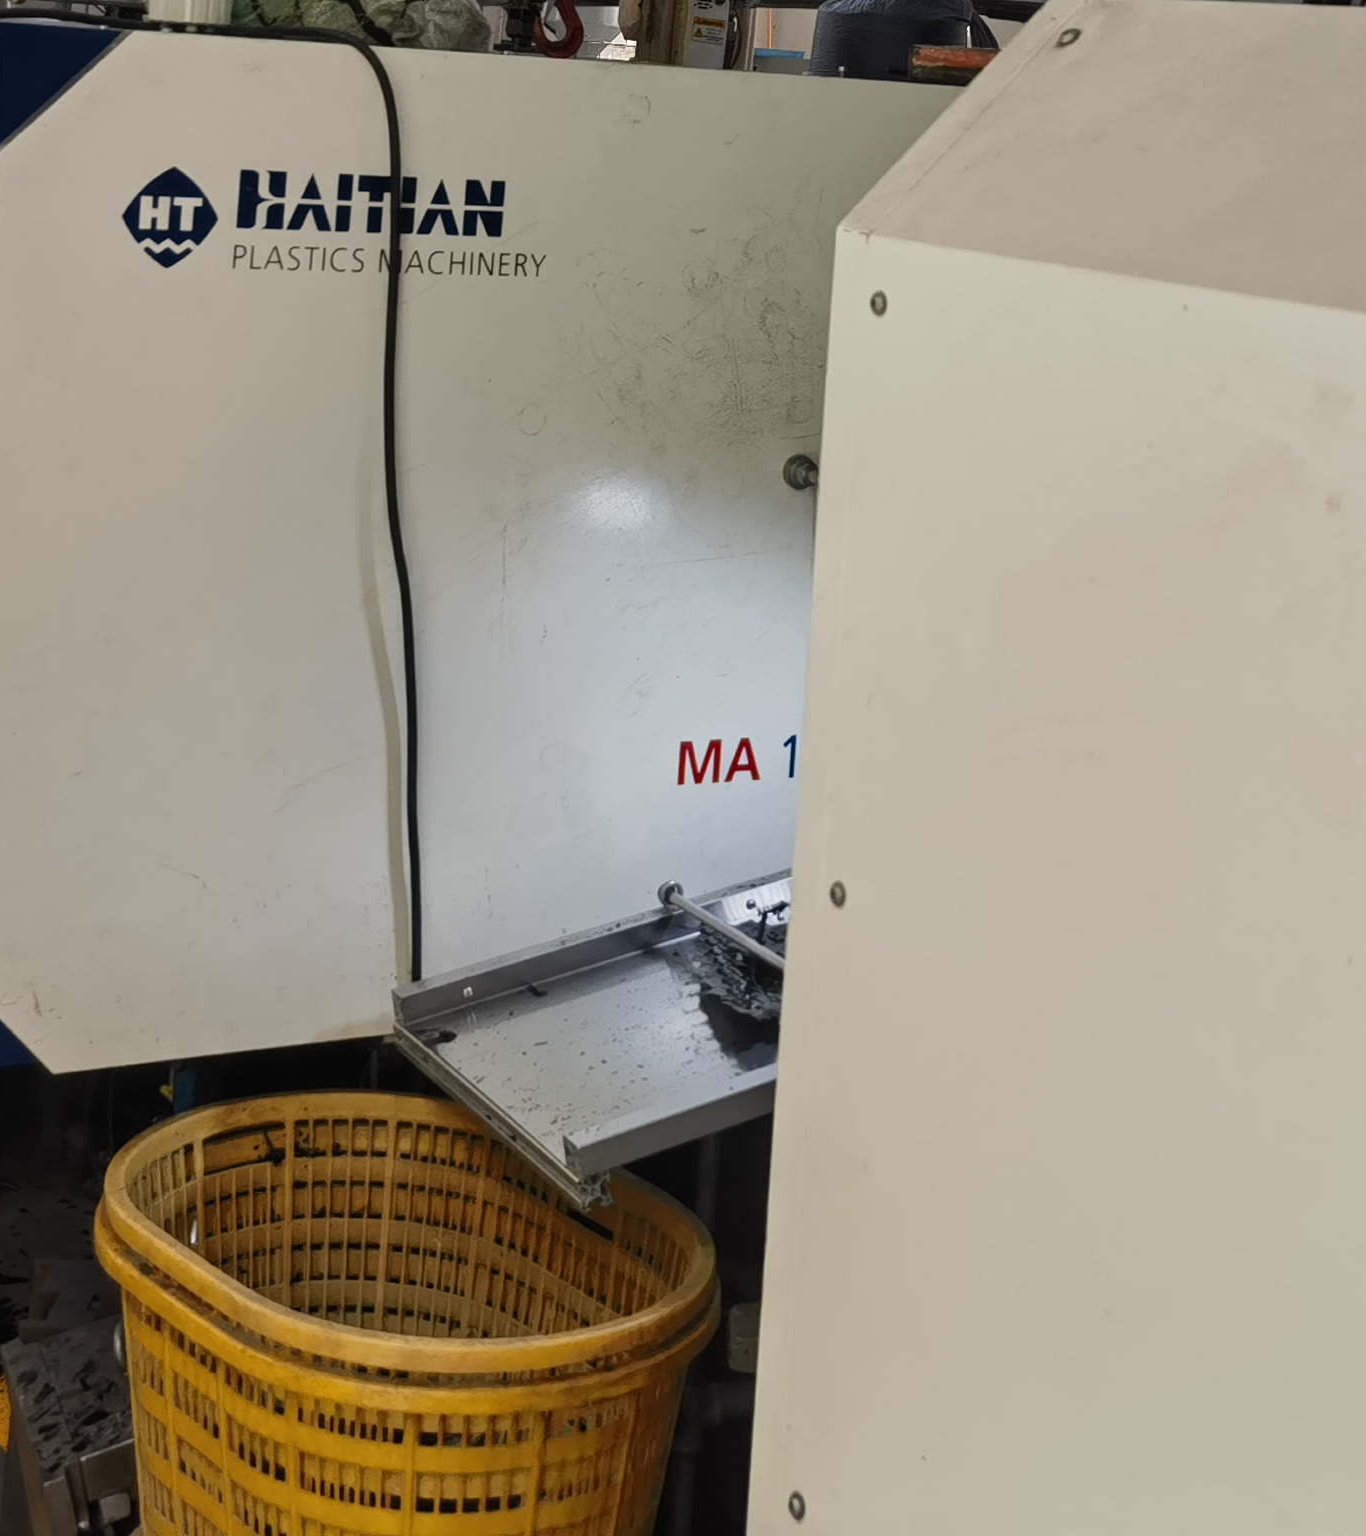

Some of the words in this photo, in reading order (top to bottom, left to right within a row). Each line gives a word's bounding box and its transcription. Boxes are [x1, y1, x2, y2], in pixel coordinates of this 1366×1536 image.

[137, 195, 203, 232] HT
[235, 169, 506, 237] HAITIAN
[231, 244, 366, 273] PLASTICS
[378, 248, 547, 278] MACHINERY
[677, 737, 761, 786] MA
